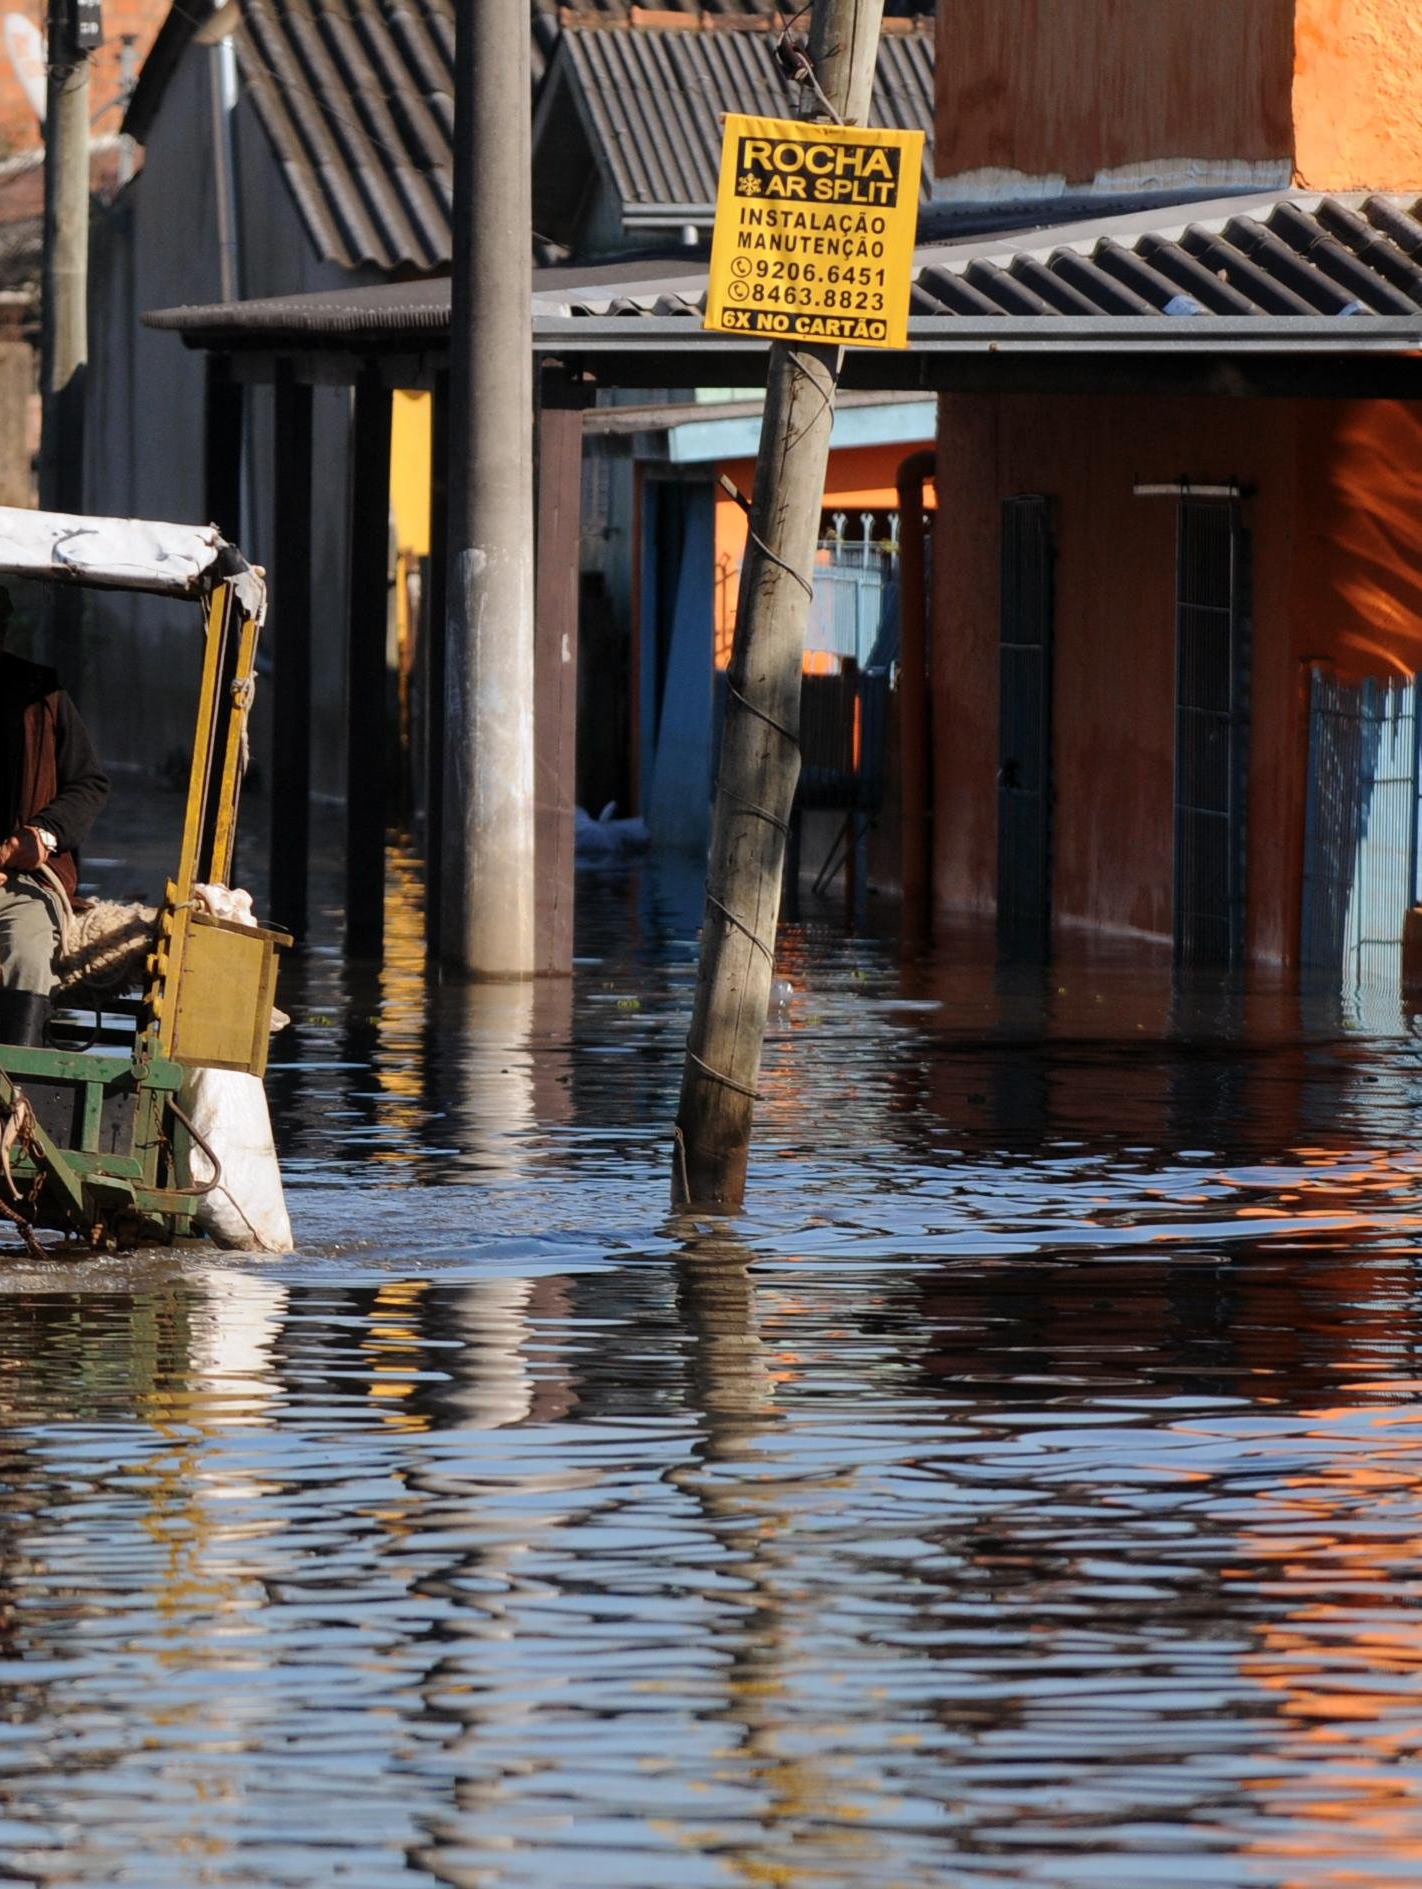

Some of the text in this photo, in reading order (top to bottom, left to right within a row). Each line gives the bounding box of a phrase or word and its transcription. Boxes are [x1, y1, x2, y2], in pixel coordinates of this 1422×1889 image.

[743, 139, 894, 179] ROCHA
[765, 174, 895, 204] AR SPLIT
[740, 207, 886, 237] INSTALAÇÃO
[737, 231, 884, 260] MANUTENÇÃO
[756, 259, 885, 287] 9206.6451
[752, 283, 884, 311] 8463.8823
[722, 310, 886, 339] 6X NO CARTÃO
